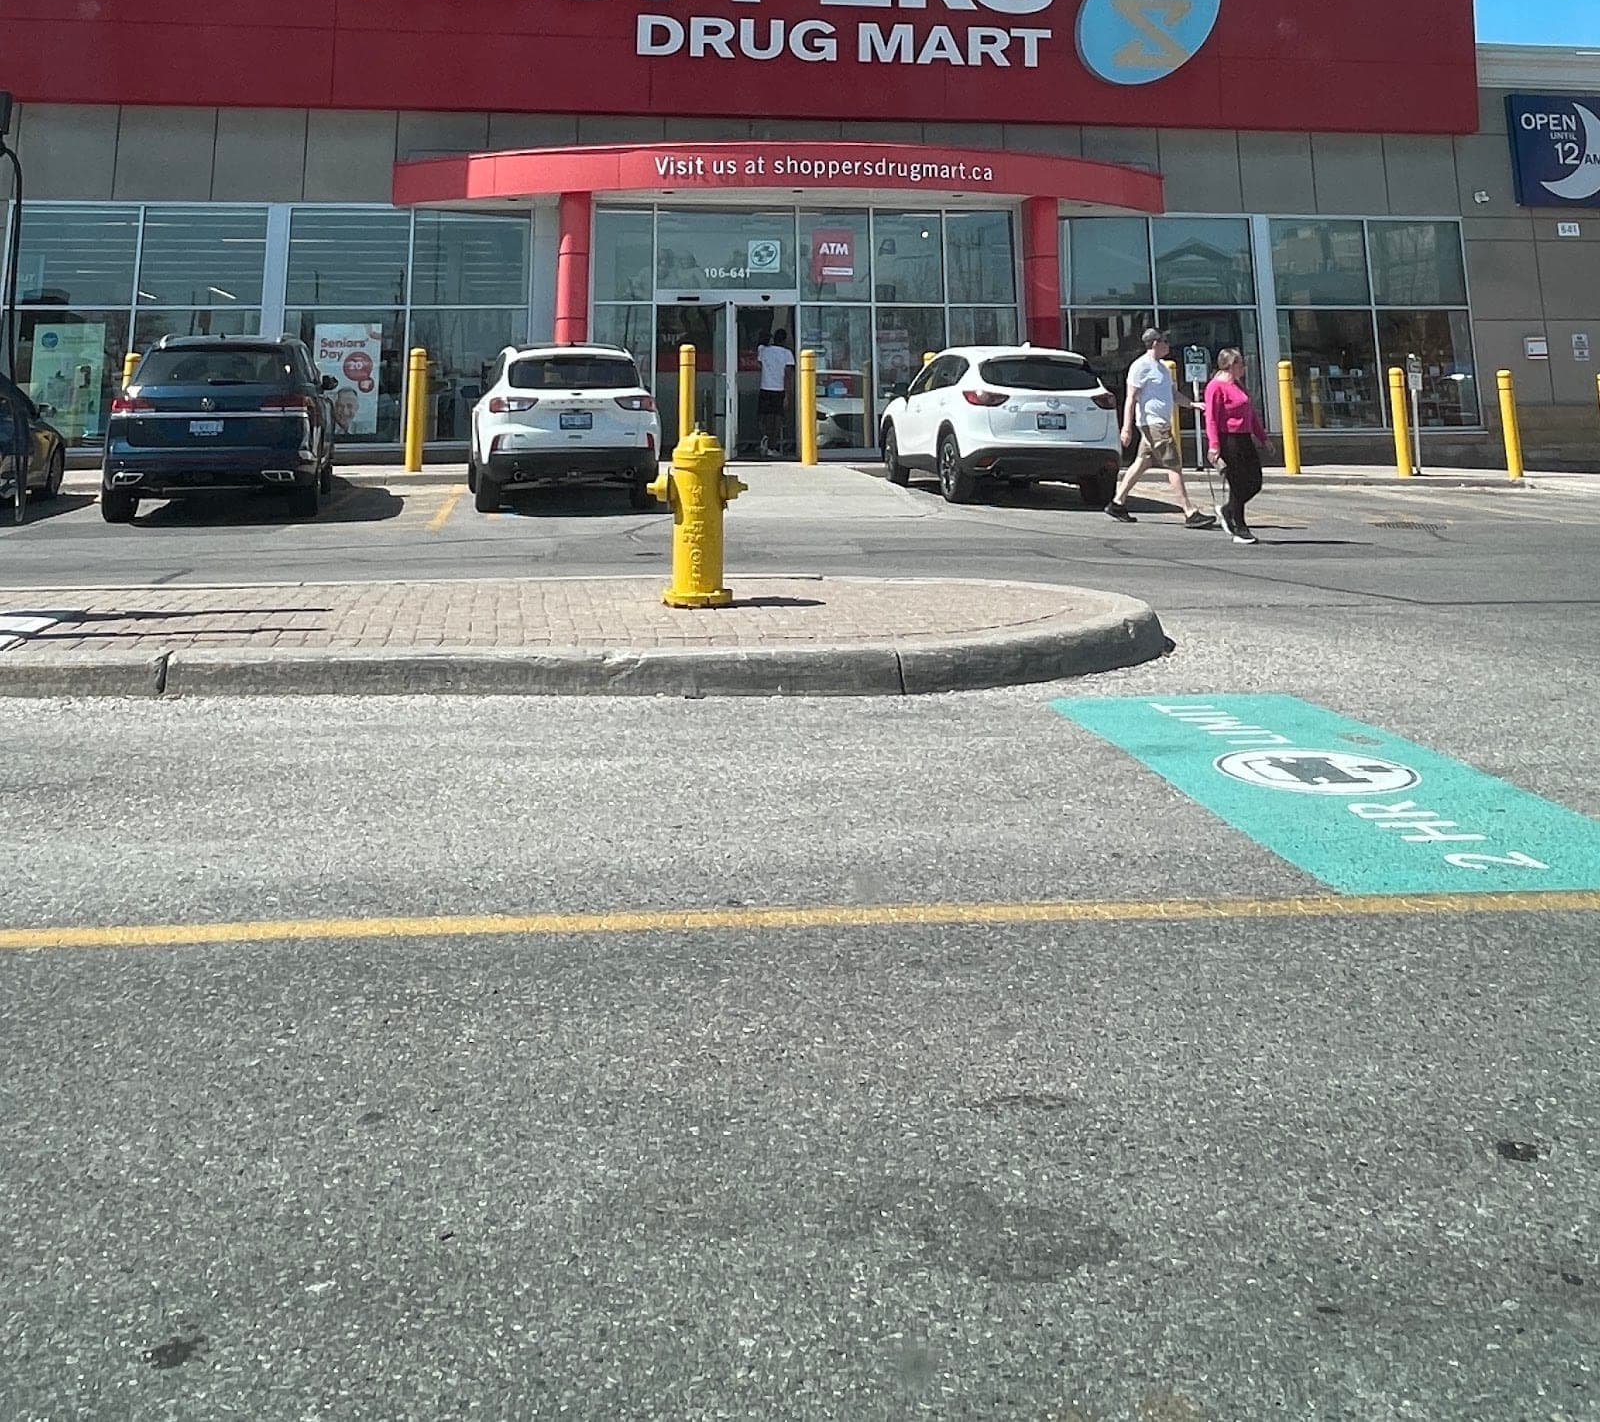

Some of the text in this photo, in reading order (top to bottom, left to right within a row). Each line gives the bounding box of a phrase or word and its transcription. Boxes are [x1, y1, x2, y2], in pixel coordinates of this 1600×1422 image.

[636, 15, 1052, 68] DRUG MART
[1520, 113, 1577, 131] OPEN
[1550, 132, 1577, 140] UNTIL
[1554, 142, 1580, 165] 12
[655, 156, 993, 181] Visit us at shoppersdrugmart.ca
[819, 242, 849, 255] ATM
[320, 349, 343, 362] Day
[1150, 702, 1291, 745] LIMIT
[1347, 800, 1550, 870] 2 HR
